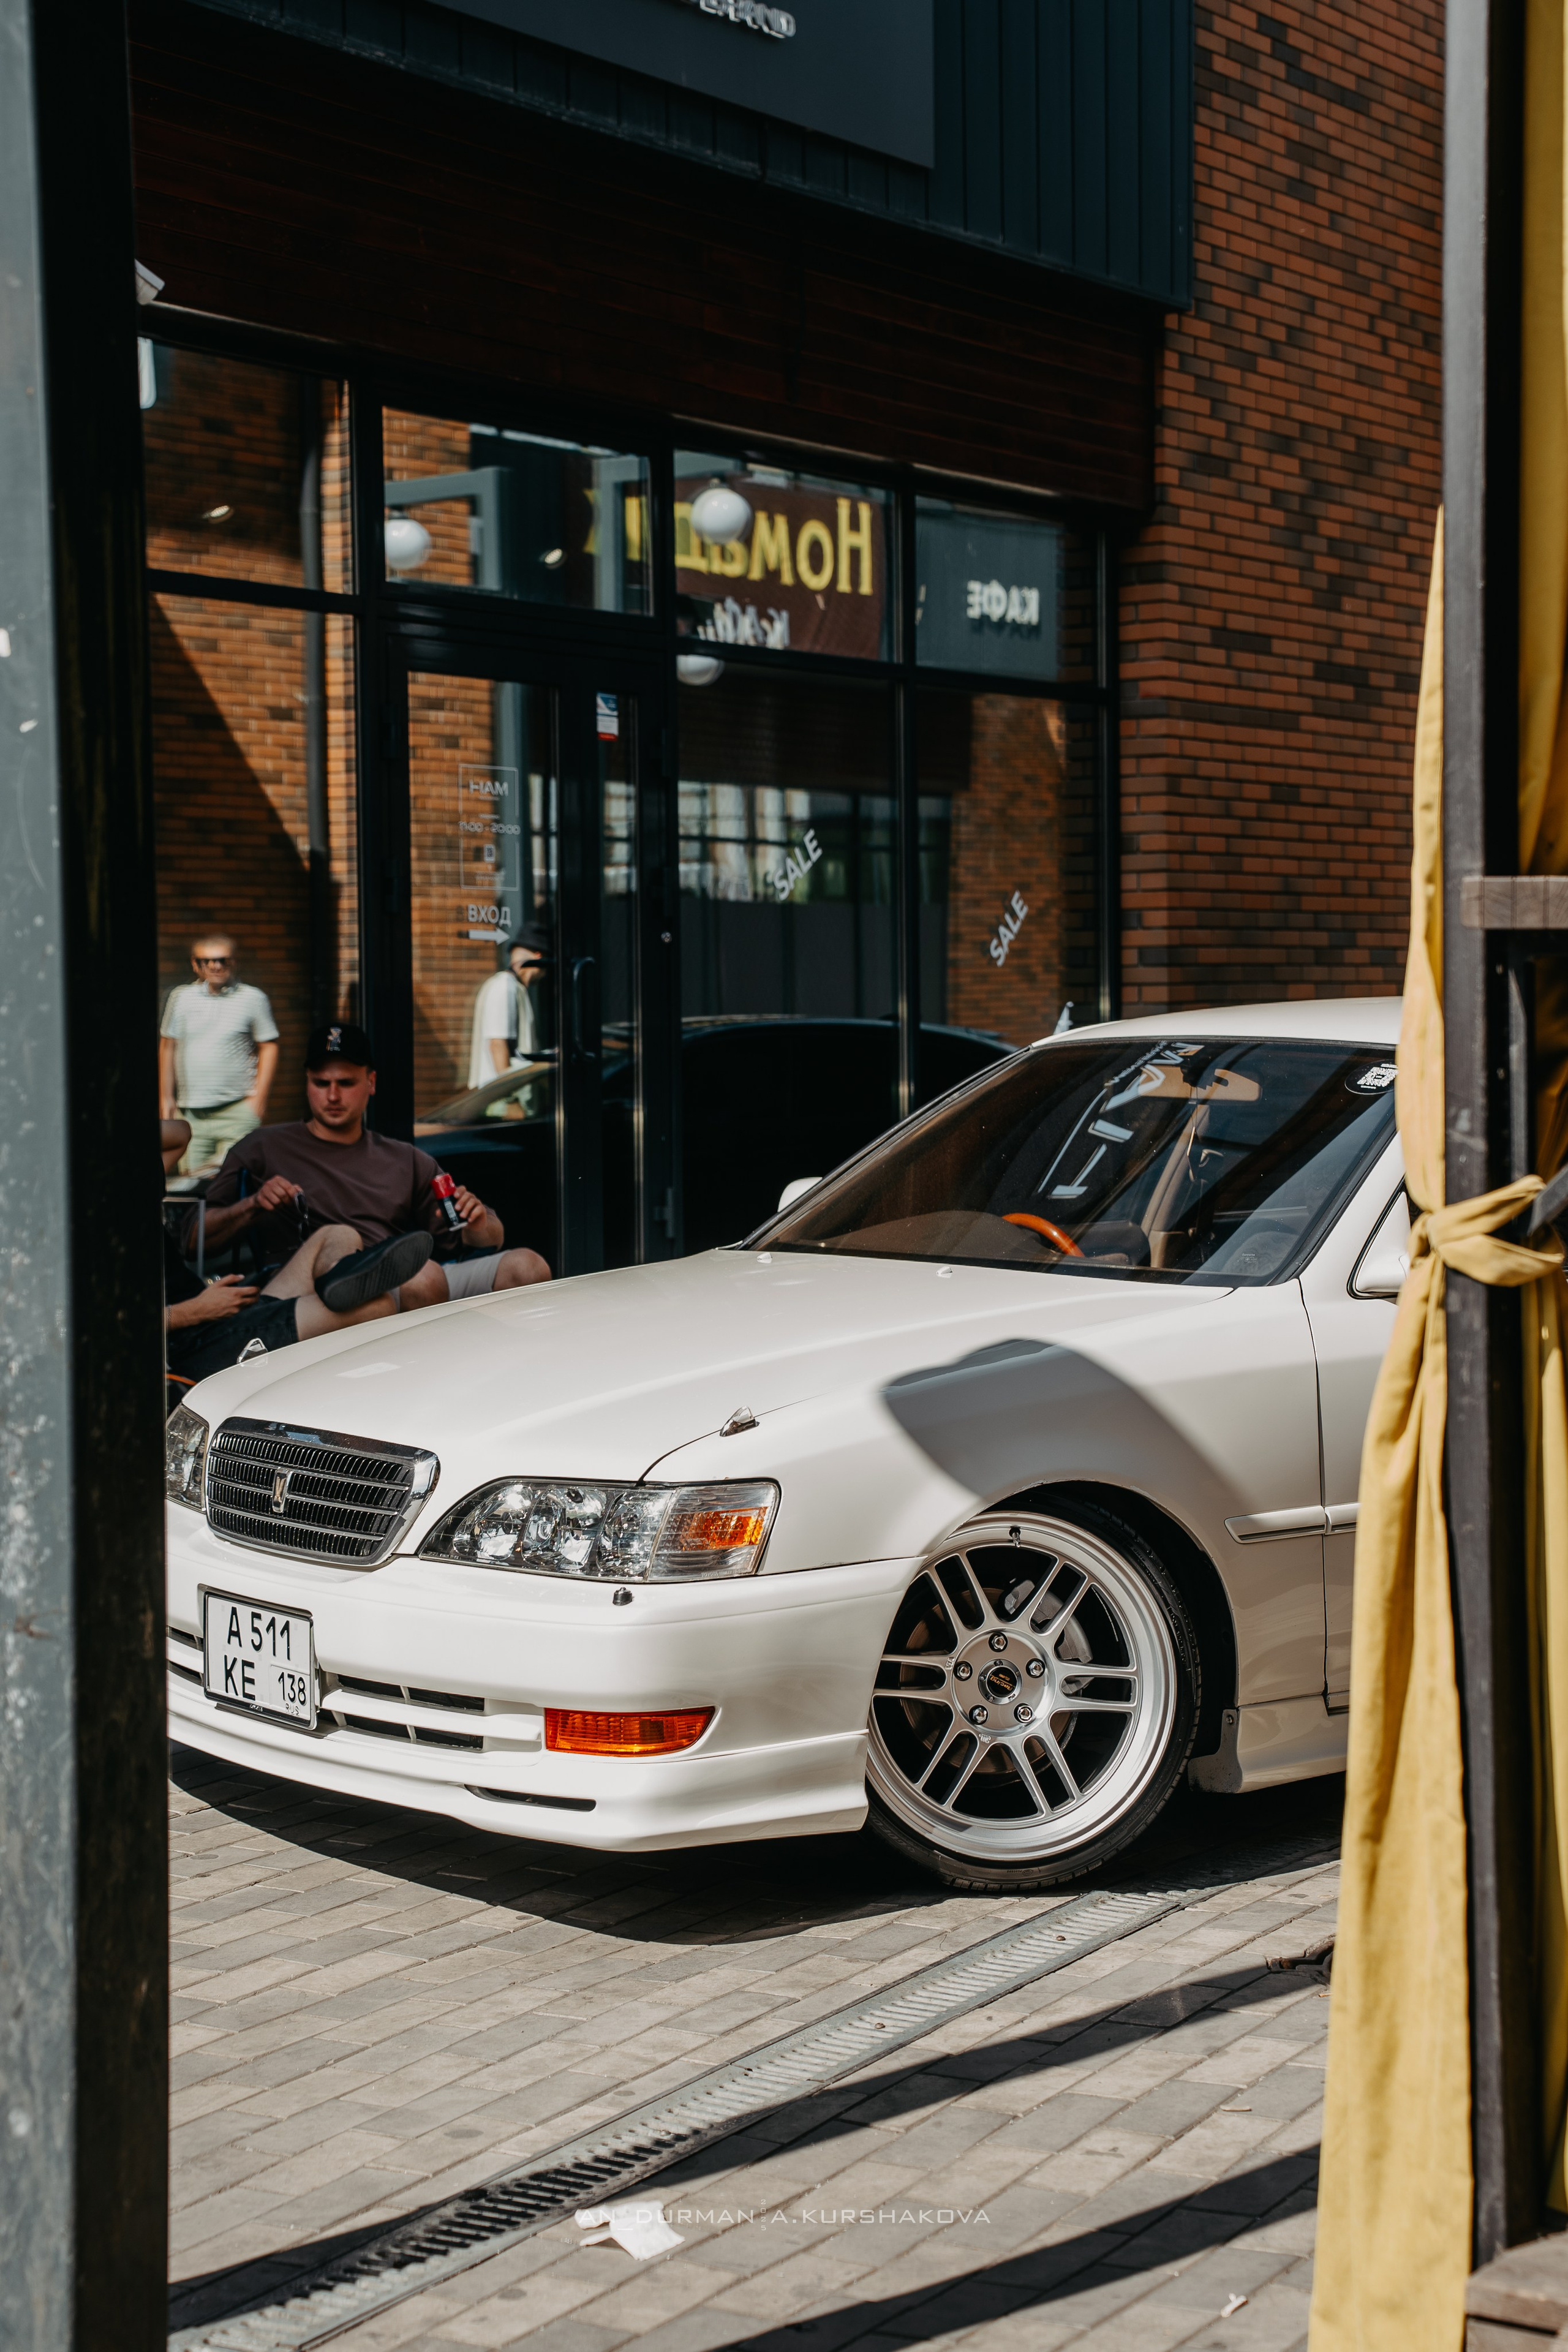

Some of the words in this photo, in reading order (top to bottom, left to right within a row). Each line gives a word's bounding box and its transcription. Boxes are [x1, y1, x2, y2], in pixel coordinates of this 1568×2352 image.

[773, 828, 823, 900] SALE
[467, 903, 512, 928] ВХОД
[990, 890, 1029, 967] SALE
[251, 1611, 291, 1661] 511
[224, 1654, 256, 1701] KE
[278, 1672, 306, 1706] 138
[285, 1703, 300, 1716] RUS
